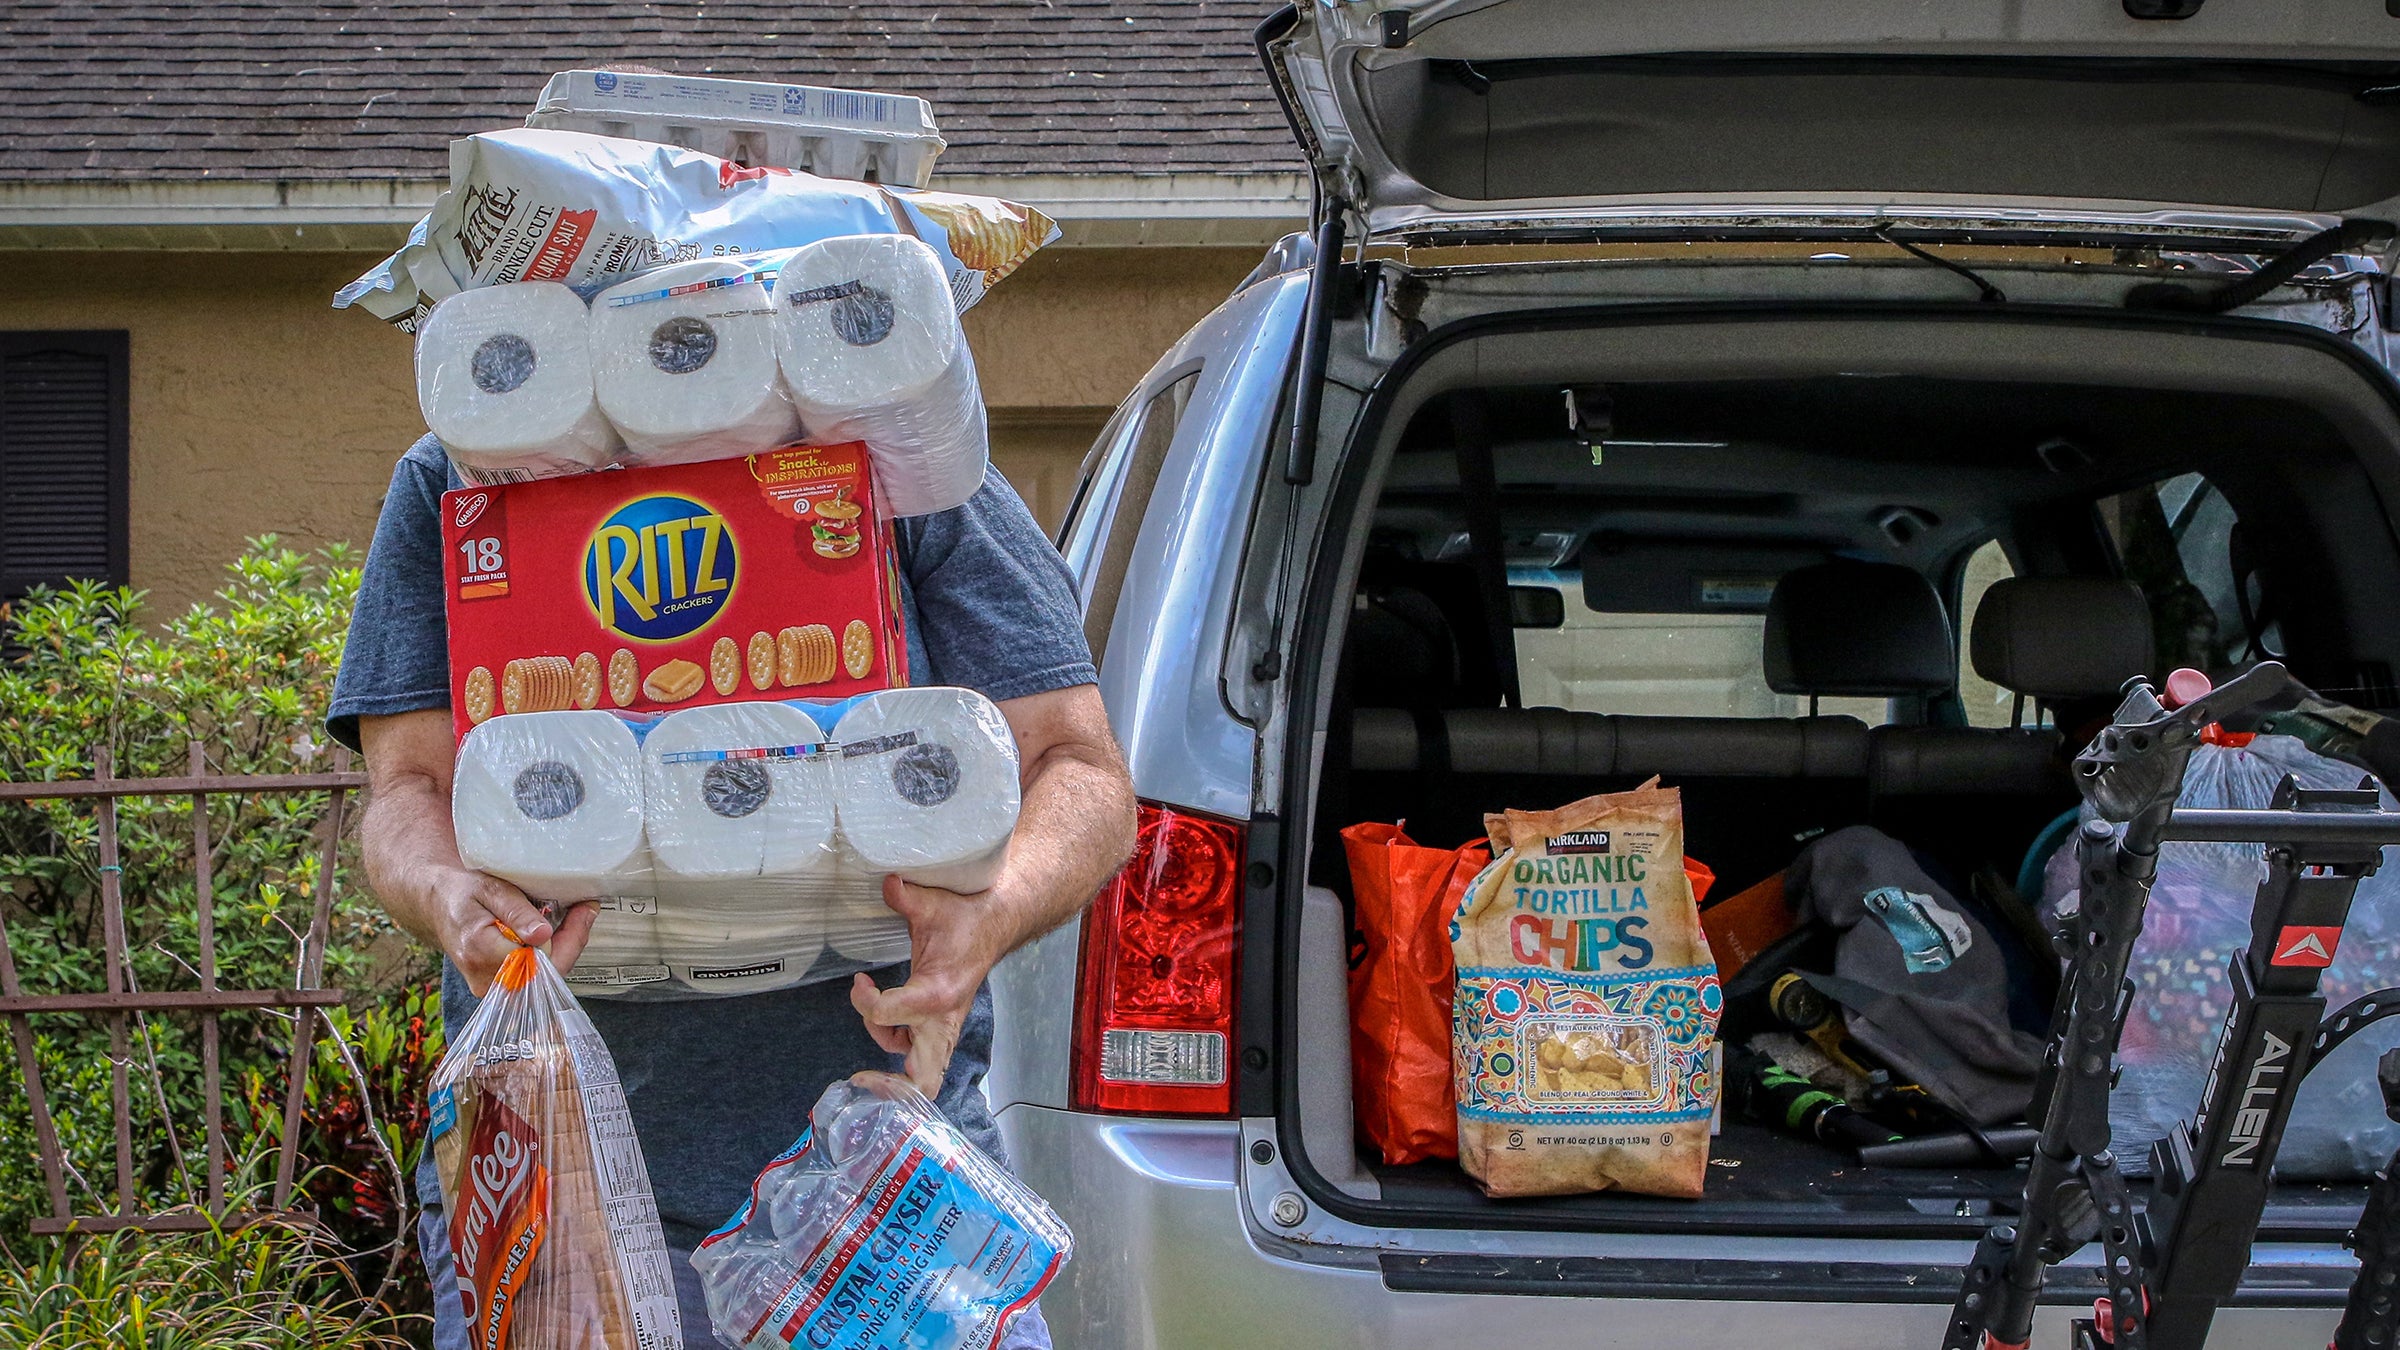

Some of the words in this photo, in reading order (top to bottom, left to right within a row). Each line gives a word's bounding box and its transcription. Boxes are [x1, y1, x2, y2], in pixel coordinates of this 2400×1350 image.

[492, 228, 519, 263] BRAND
[553, 218, 579, 247] SALT
[565, 236, 584, 265] CHIPS
[608, 235, 633, 273] PROMISE
[765, 462, 856, 483] INSPIRATIONS!
[779, 456, 818, 471] Snack
[458, 496, 485, 525] NABISCO
[460, 537, 503, 573] 18
[474, 574, 490, 582] FRESH
[490, 572, 507, 580] PACKS
[594, 514, 728, 629] RITZ
[663, 596, 713, 614] CRACKERS
[1549, 832, 1608, 847] KIRKLAND
[1514, 854, 1646, 885] ORGANIC
[1514, 887, 1649, 915] TORTILLA
[1510, 914, 1653, 971] CHIPS
[697, 966, 777, 979] KIRKLAND
[1529, 1042, 1535, 1053] AN
[2221, 1030, 2291, 1166] ALLEN
[1588, 1137, 1596, 1146] (2
[1615, 1137, 1626, 1146] oz)
[1641, 1136, 1650, 1146] kg
[471, 1131, 530, 1228] Lee
[804, 1265, 840, 1312] BOTTLED
[841, 1247, 853, 1264] AT
[855, 1224, 872, 1245] THE
[872, 1179, 902, 1221] SOURCE
[884, 1255, 929, 1313] SPRING
[924, 1206, 963, 1258] WATER
[806, 1262, 881, 1349] CRYSTAL
[871, 1174, 944, 1264] GEYSER
[983, 1255, 998, 1277] CRYSTAL
[486, 1286, 509, 1350] HONEY
[500, 1225, 537, 1286] WHEAT
[857, 1232, 929, 1323] NATURAL
[772, 1288, 800, 1324] CRYSTAL
[901, 1309, 910, 1322] BY
[908, 1298, 919, 1313] CG
[917, 1272, 939, 1301] ROXANE
[963, 1337, 971, 1348] FL
[970, 1328, 979, 1340] OZ
[976, 1339, 984, 1349] OZ
